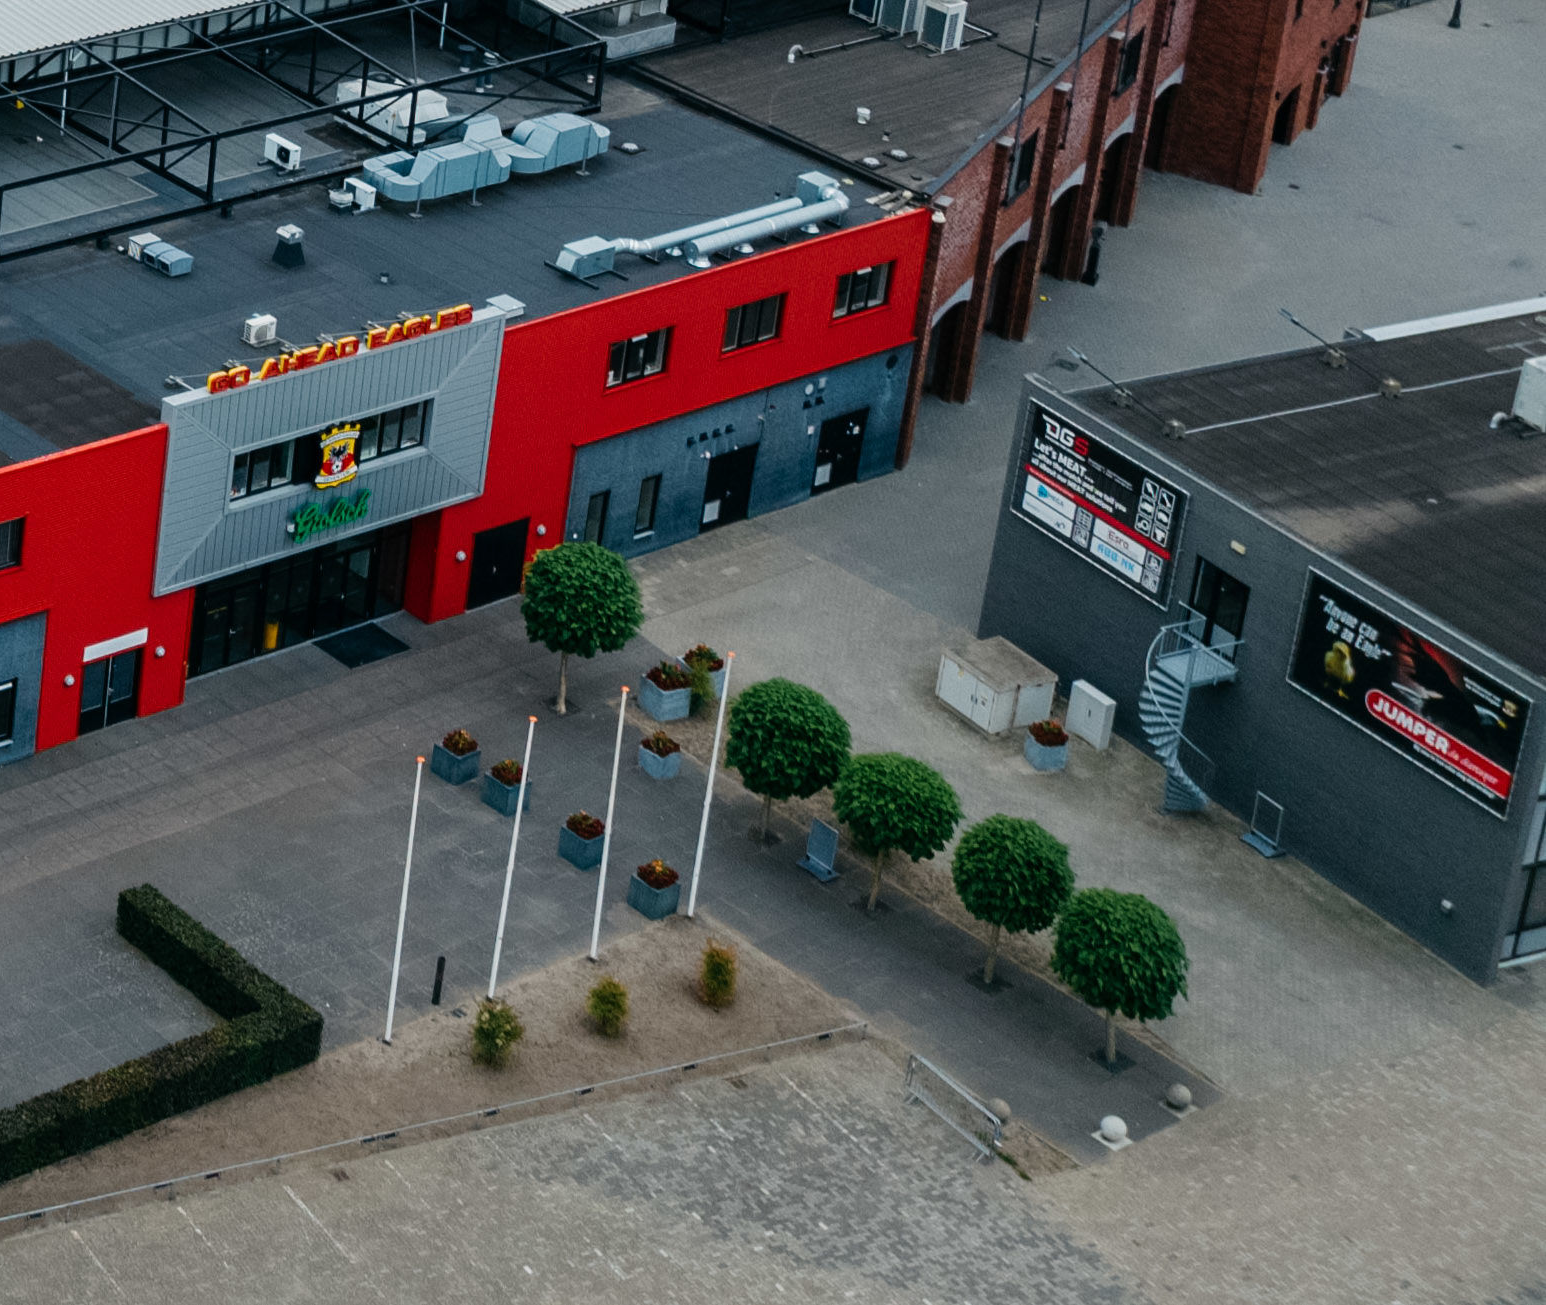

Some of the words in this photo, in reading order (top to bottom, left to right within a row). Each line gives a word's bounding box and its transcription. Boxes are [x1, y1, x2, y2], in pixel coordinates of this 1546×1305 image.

[207, 365, 251, 394] GO
[259, 335, 360, 381] AHEAD
[366, 303, 474, 349] EAGLES
[1042, 413, 1090, 457] DGS
[293, 488, 372, 544] Grolsch
[1372, 697, 1449, 754] JUMPER
